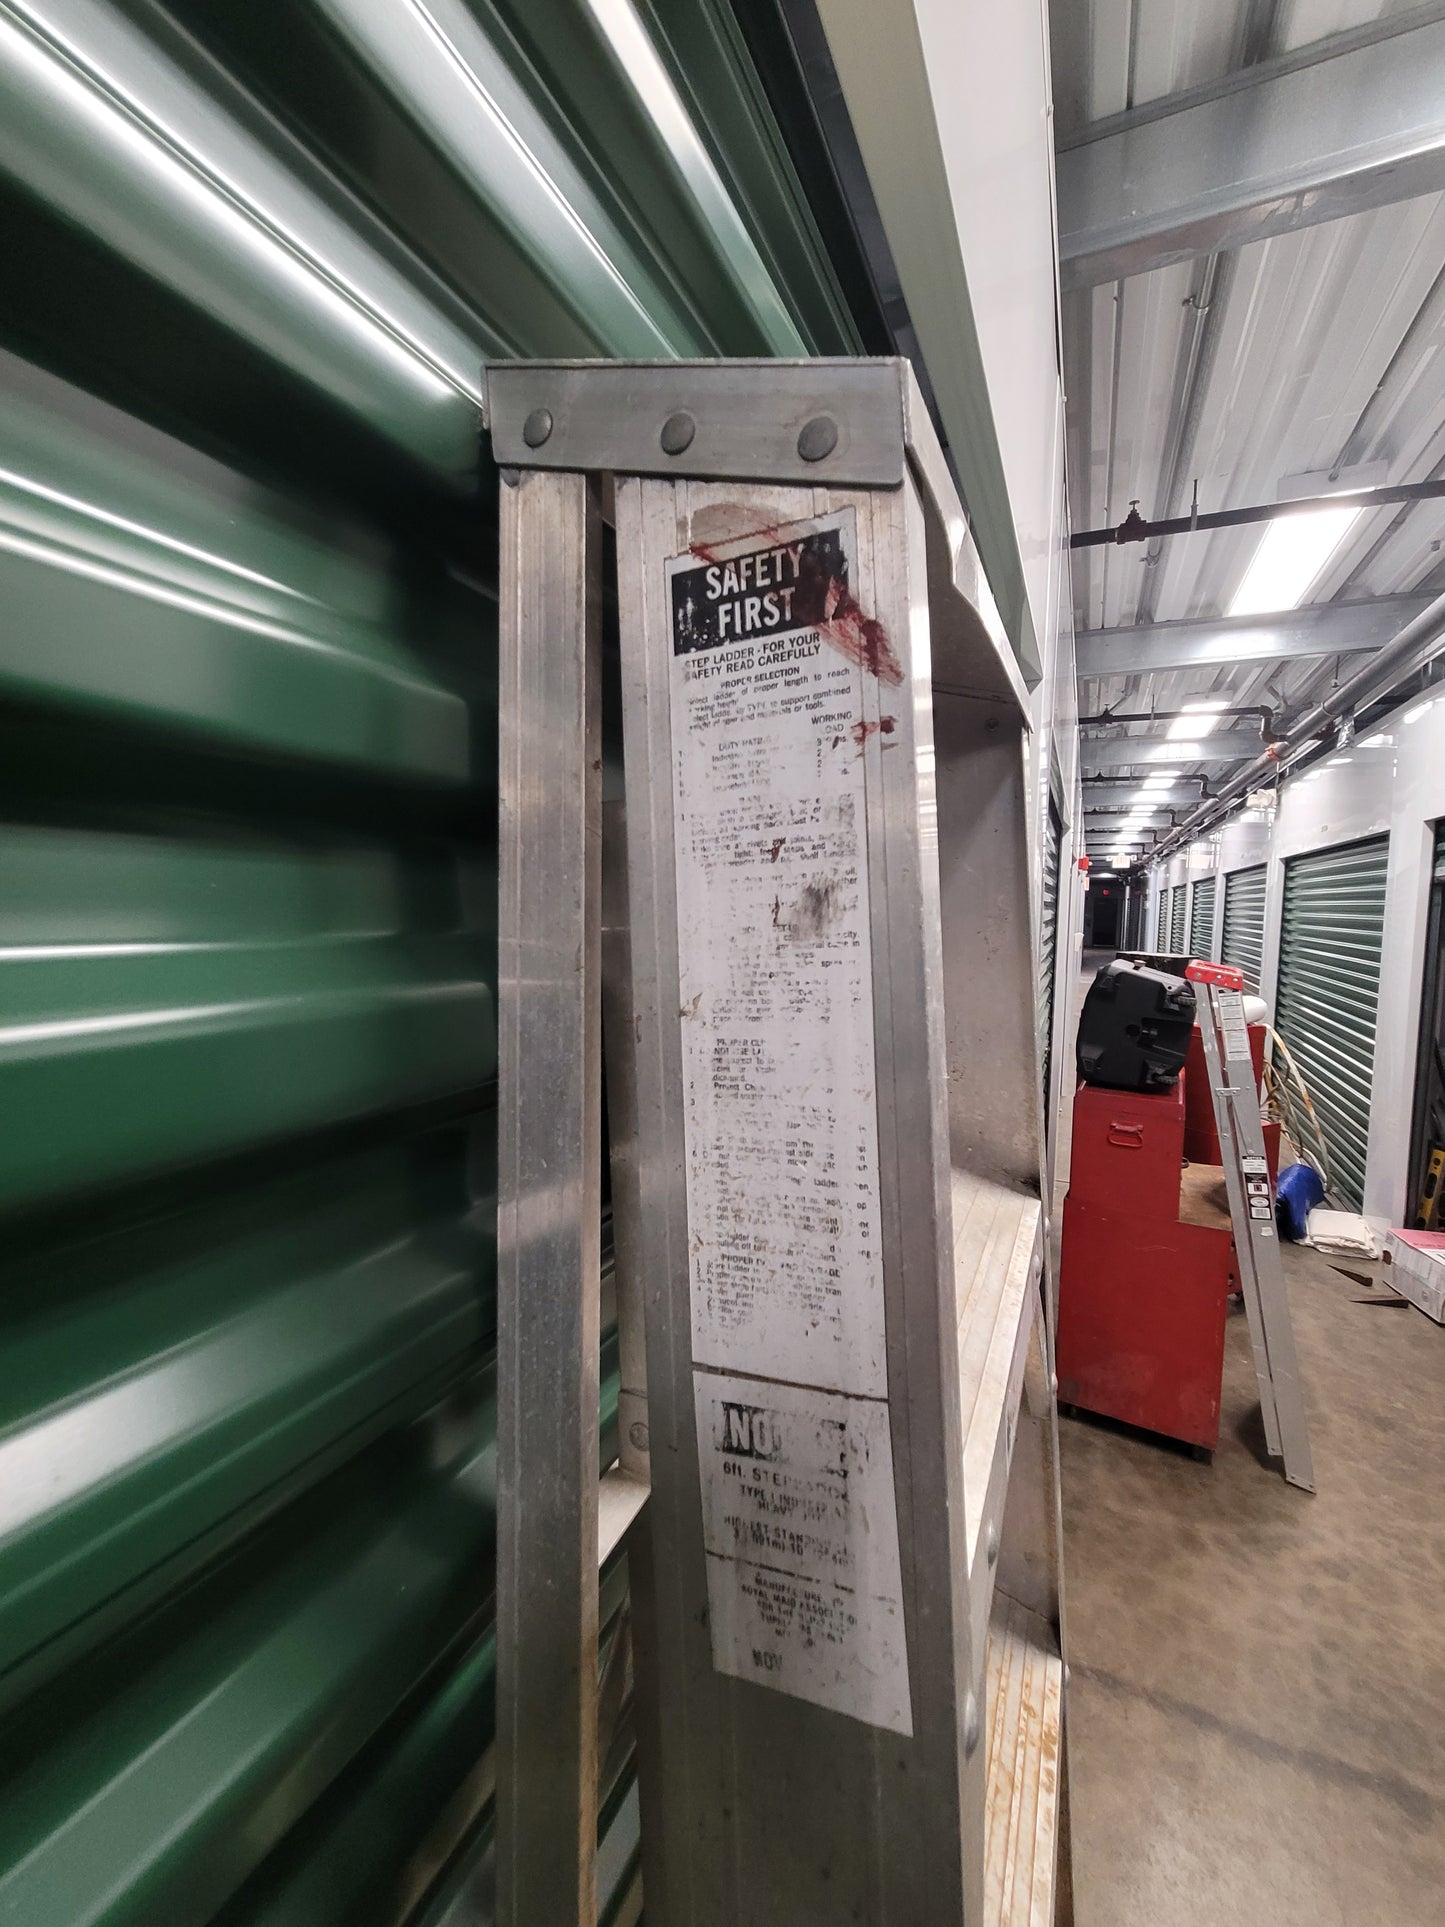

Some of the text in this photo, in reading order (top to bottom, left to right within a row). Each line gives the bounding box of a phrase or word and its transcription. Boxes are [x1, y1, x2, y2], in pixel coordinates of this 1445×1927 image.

[706, 543, 806, 600] SAFETY
[718, 587, 796, 638] FIRST
[713, 646, 754, 664] LADDER
[762, 640, 785, 654] FOR
[788, 631, 821, 648] YOUR
[726, 659, 755, 673] READ
[758, 644, 821, 667] CAREFULLY
[754, 666, 800, 683] SELECTION
[784, 675, 809, 688] length
[814, 673, 823, 681] to
[827, 667, 850, 678] reach
[780, 694, 811, 708] support
[811, 711, 852, 725] WORKING
